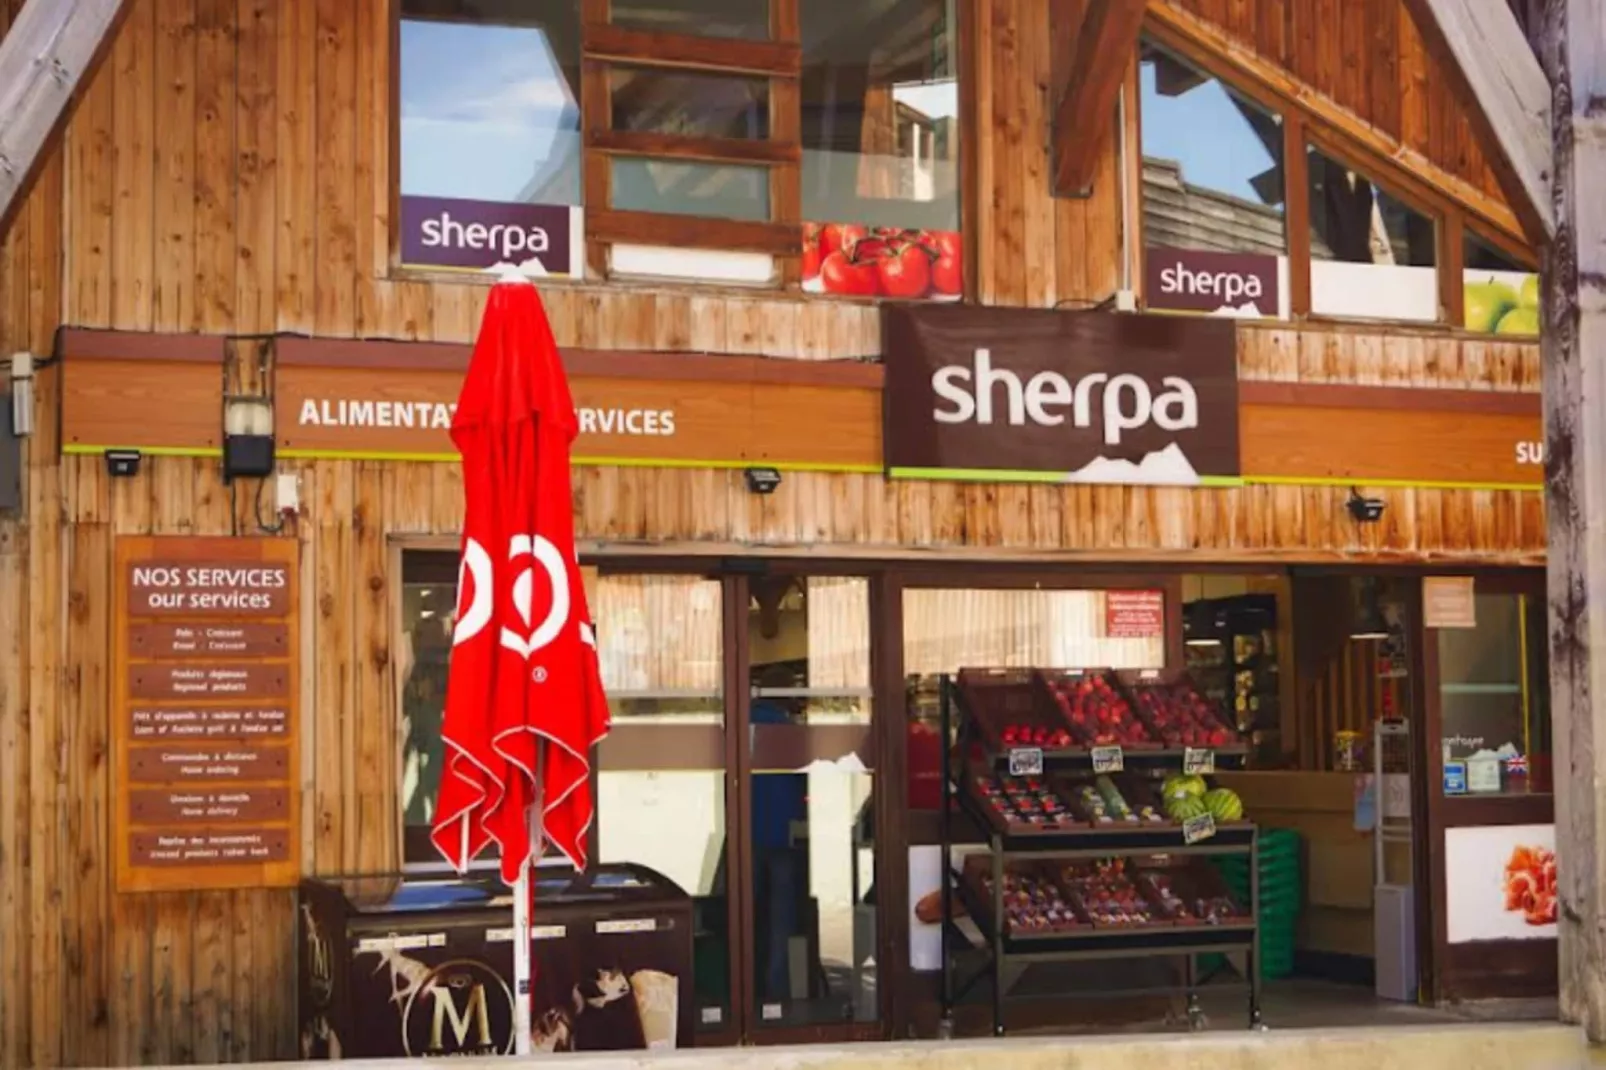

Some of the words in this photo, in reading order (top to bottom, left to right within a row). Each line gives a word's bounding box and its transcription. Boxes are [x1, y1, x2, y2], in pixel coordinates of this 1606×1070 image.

[421, 211, 549, 258] sherpa
[1160, 261, 1263, 303] sherpa
[931, 348, 1199, 445] sherpa
[574, 408, 675, 436] RVICES
[133, 567, 181, 587] NOS
[186, 568, 285, 587] SERVICES
[148, 592, 185, 608] our
[189, 590, 271, 608] services
[428, 984, 493, 1049] M
